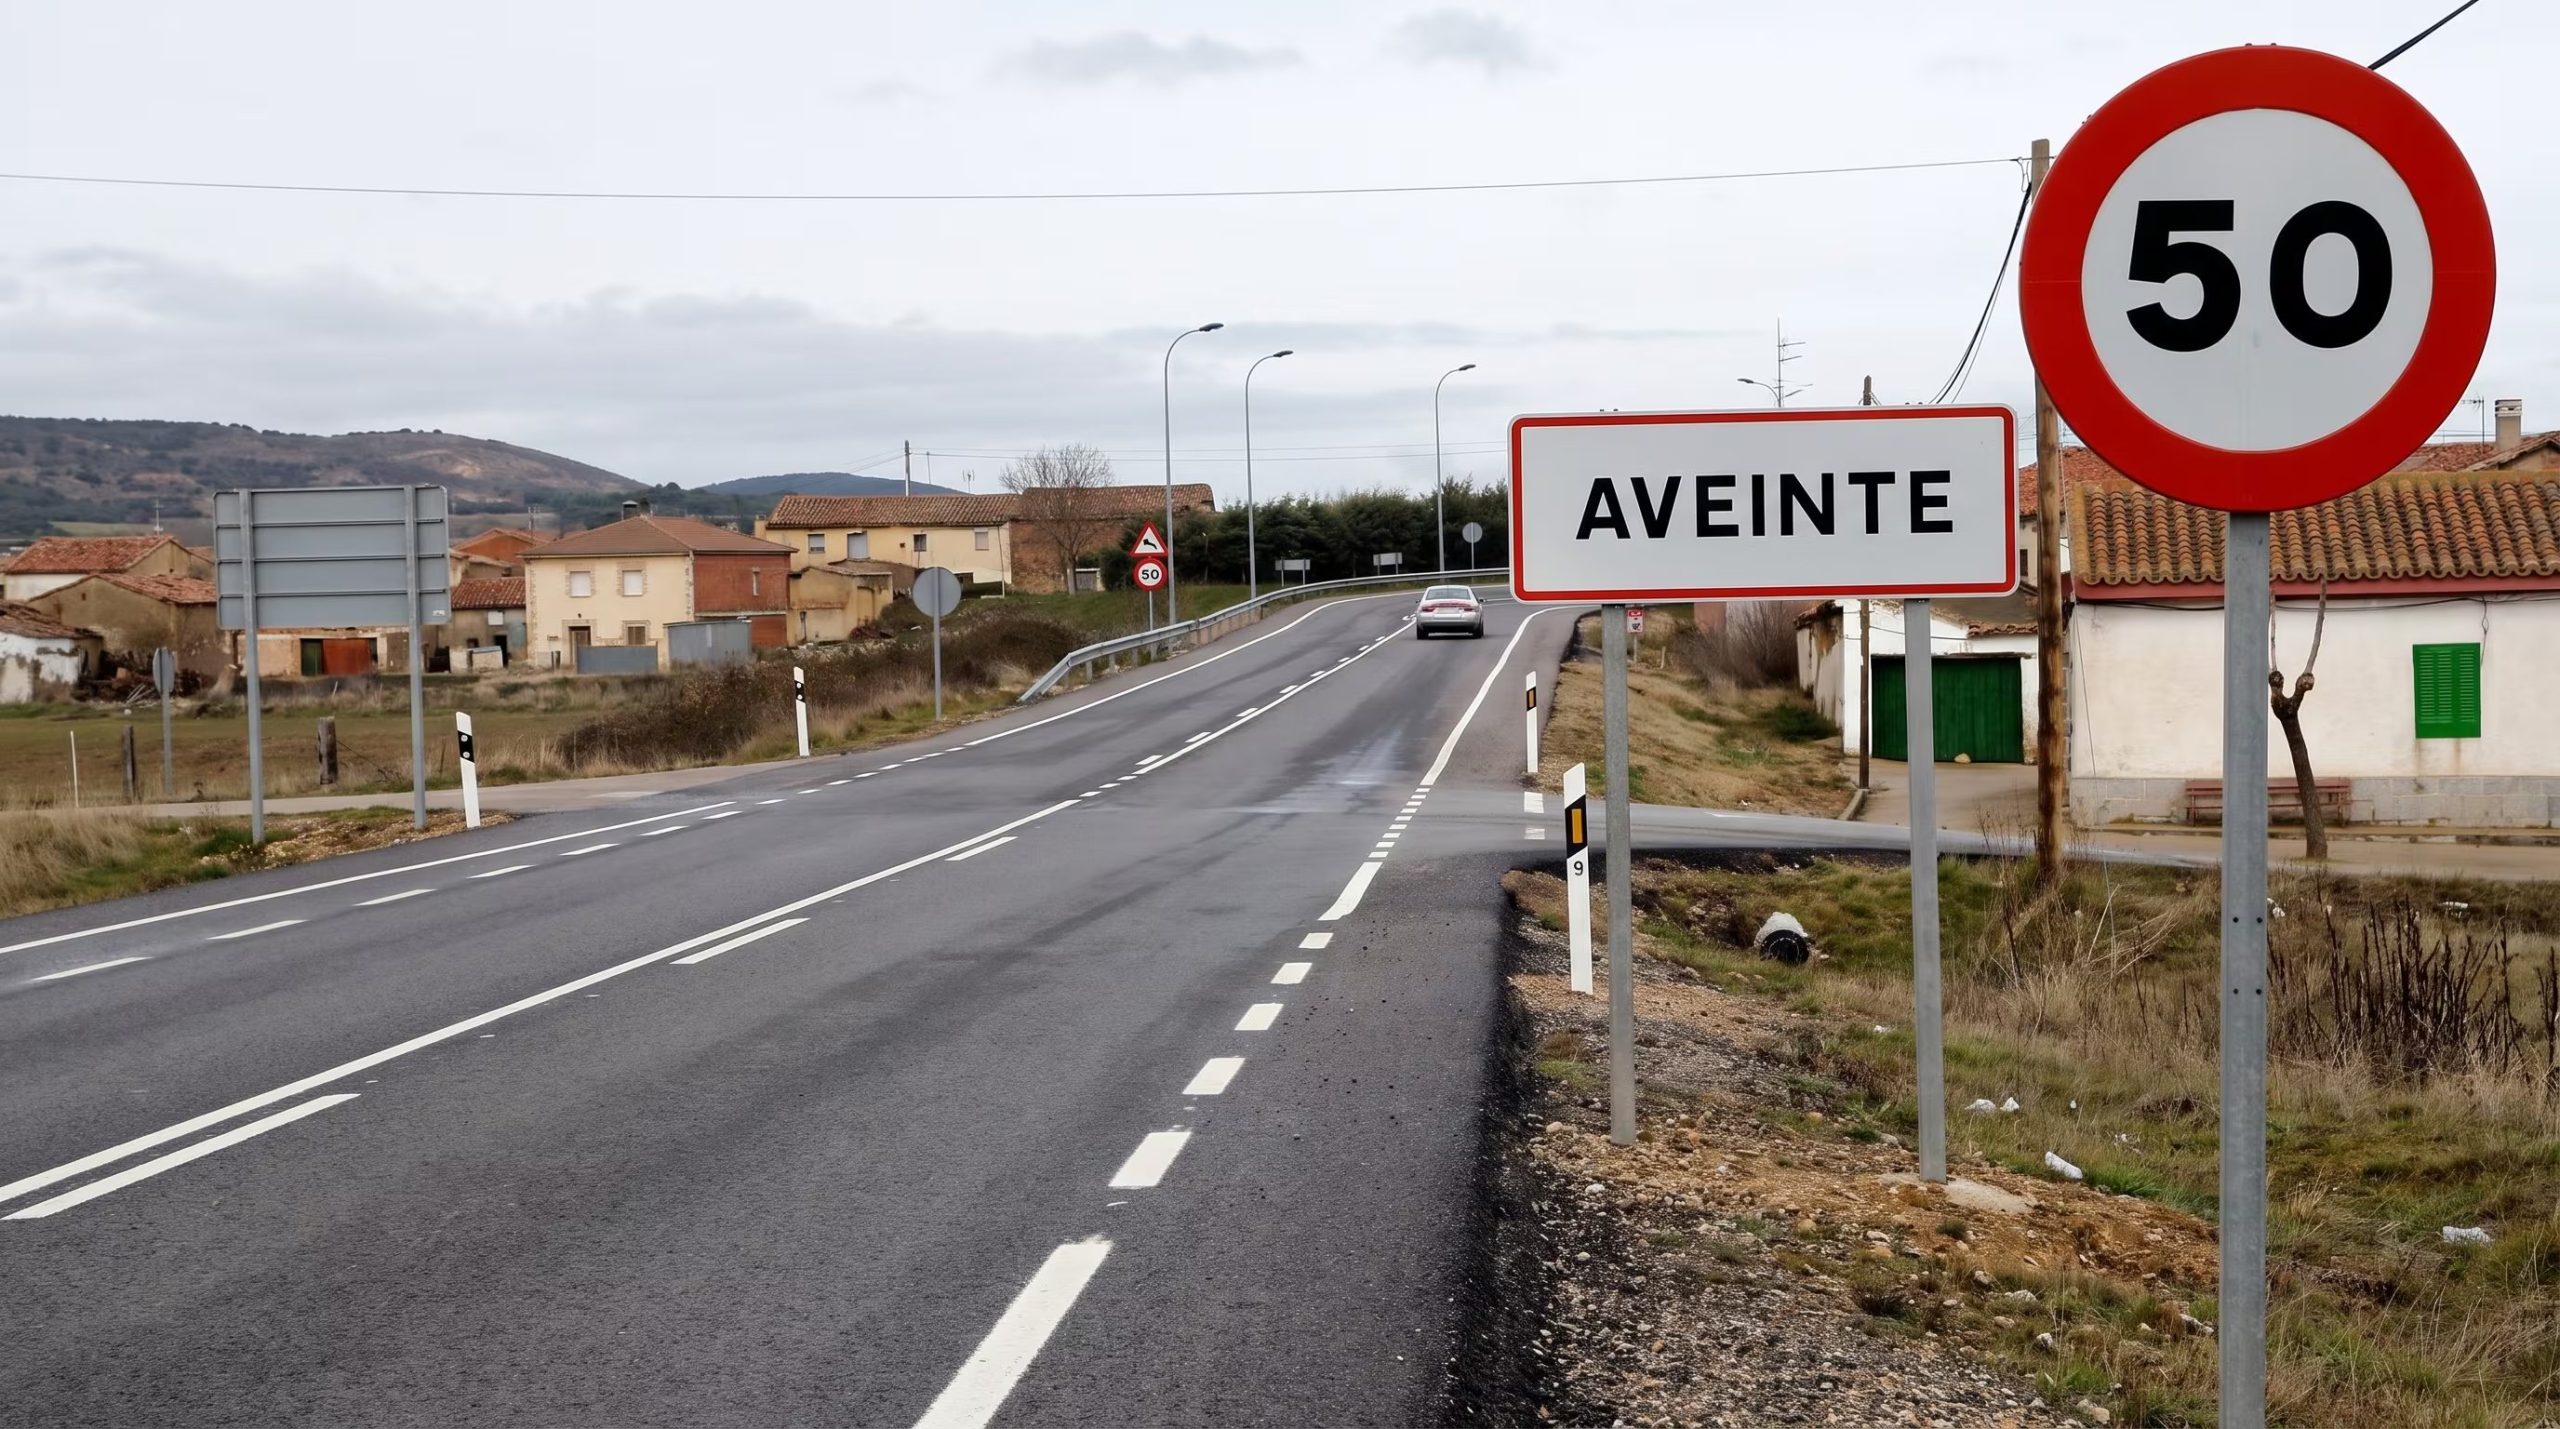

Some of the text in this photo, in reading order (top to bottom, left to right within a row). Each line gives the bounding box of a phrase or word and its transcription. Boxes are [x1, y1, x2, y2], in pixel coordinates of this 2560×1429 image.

[2126, 199, 2393, 353] 50
[1575, 469, 1954, 540] AVEINTE
[1141, 569, 1160, 580] 50
[1573, 860, 1584, 876] 9
